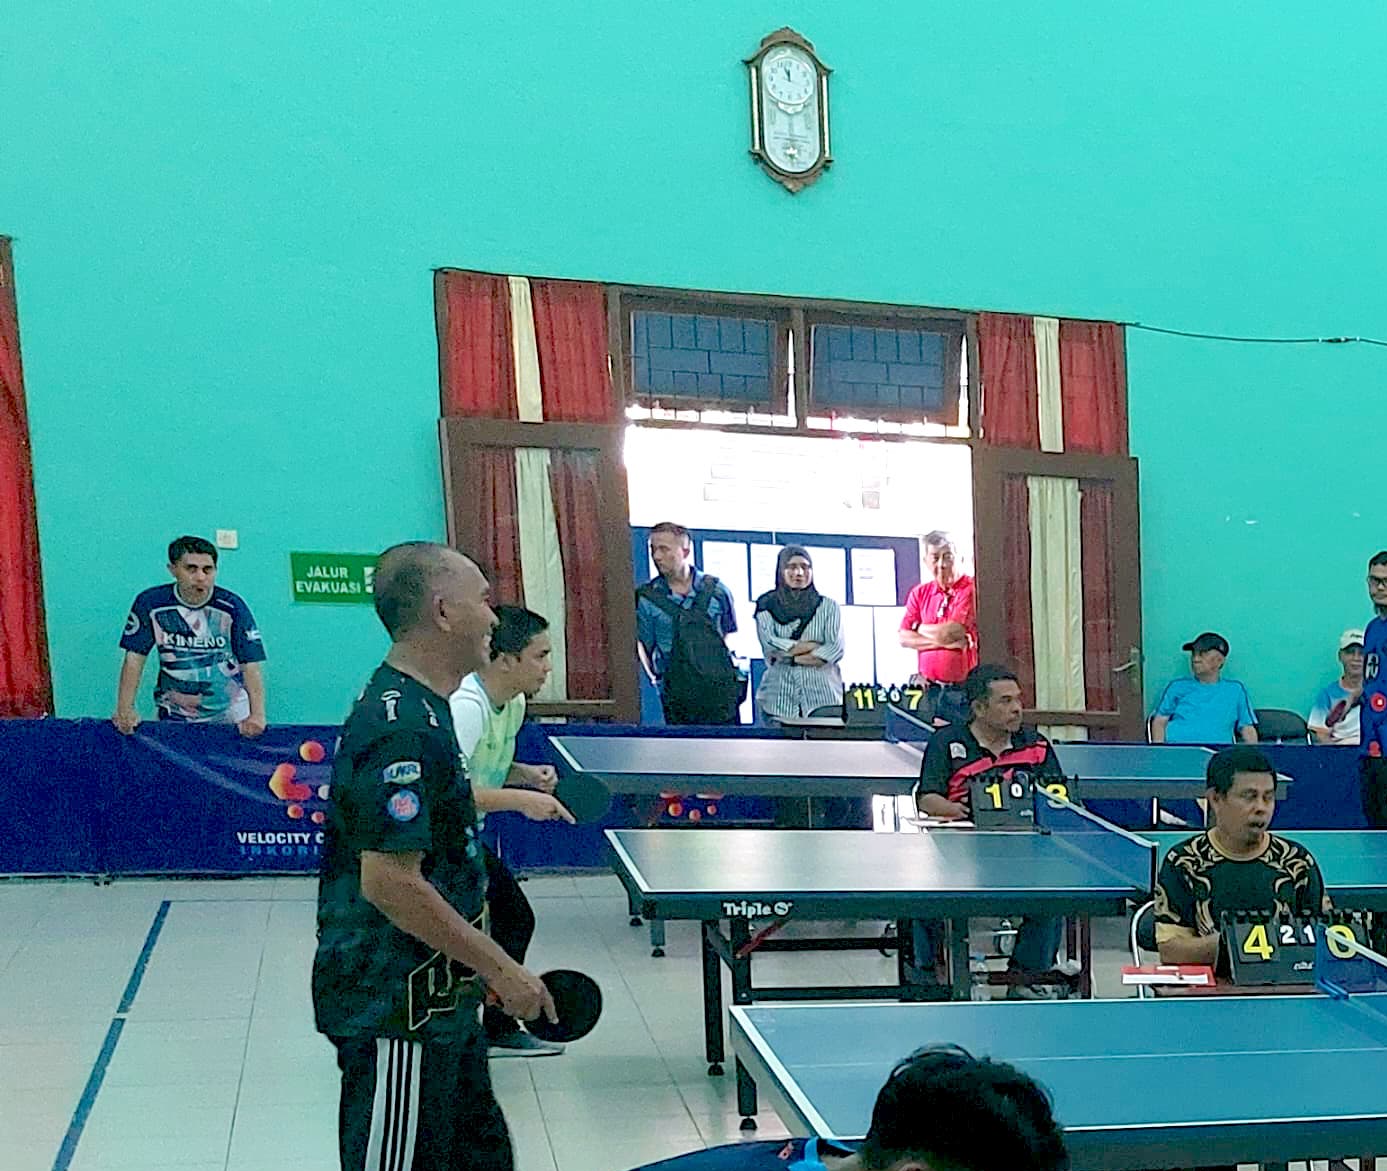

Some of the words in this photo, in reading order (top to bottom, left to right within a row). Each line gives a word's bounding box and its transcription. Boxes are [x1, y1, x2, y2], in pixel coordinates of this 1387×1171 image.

[307, 566, 348, 578] JALUR
[296, 581, 361, 593] EVAKUASI
[854, 688, 874, 710] 11
[904, 689, 923, 711] 7
[986, 783, 1003, 809] 1
[1011, 783, 1023, 798] 0
[237, 832, 310, 844] VELOCITY
[723, 900, 773, 919] Triple
[1243, 925, 1274, 960] 4
[1279, 924, 1297, 944] 2
[1303, 924, 1316, 944] 1
[1326, 924, 1358, 959] 0
